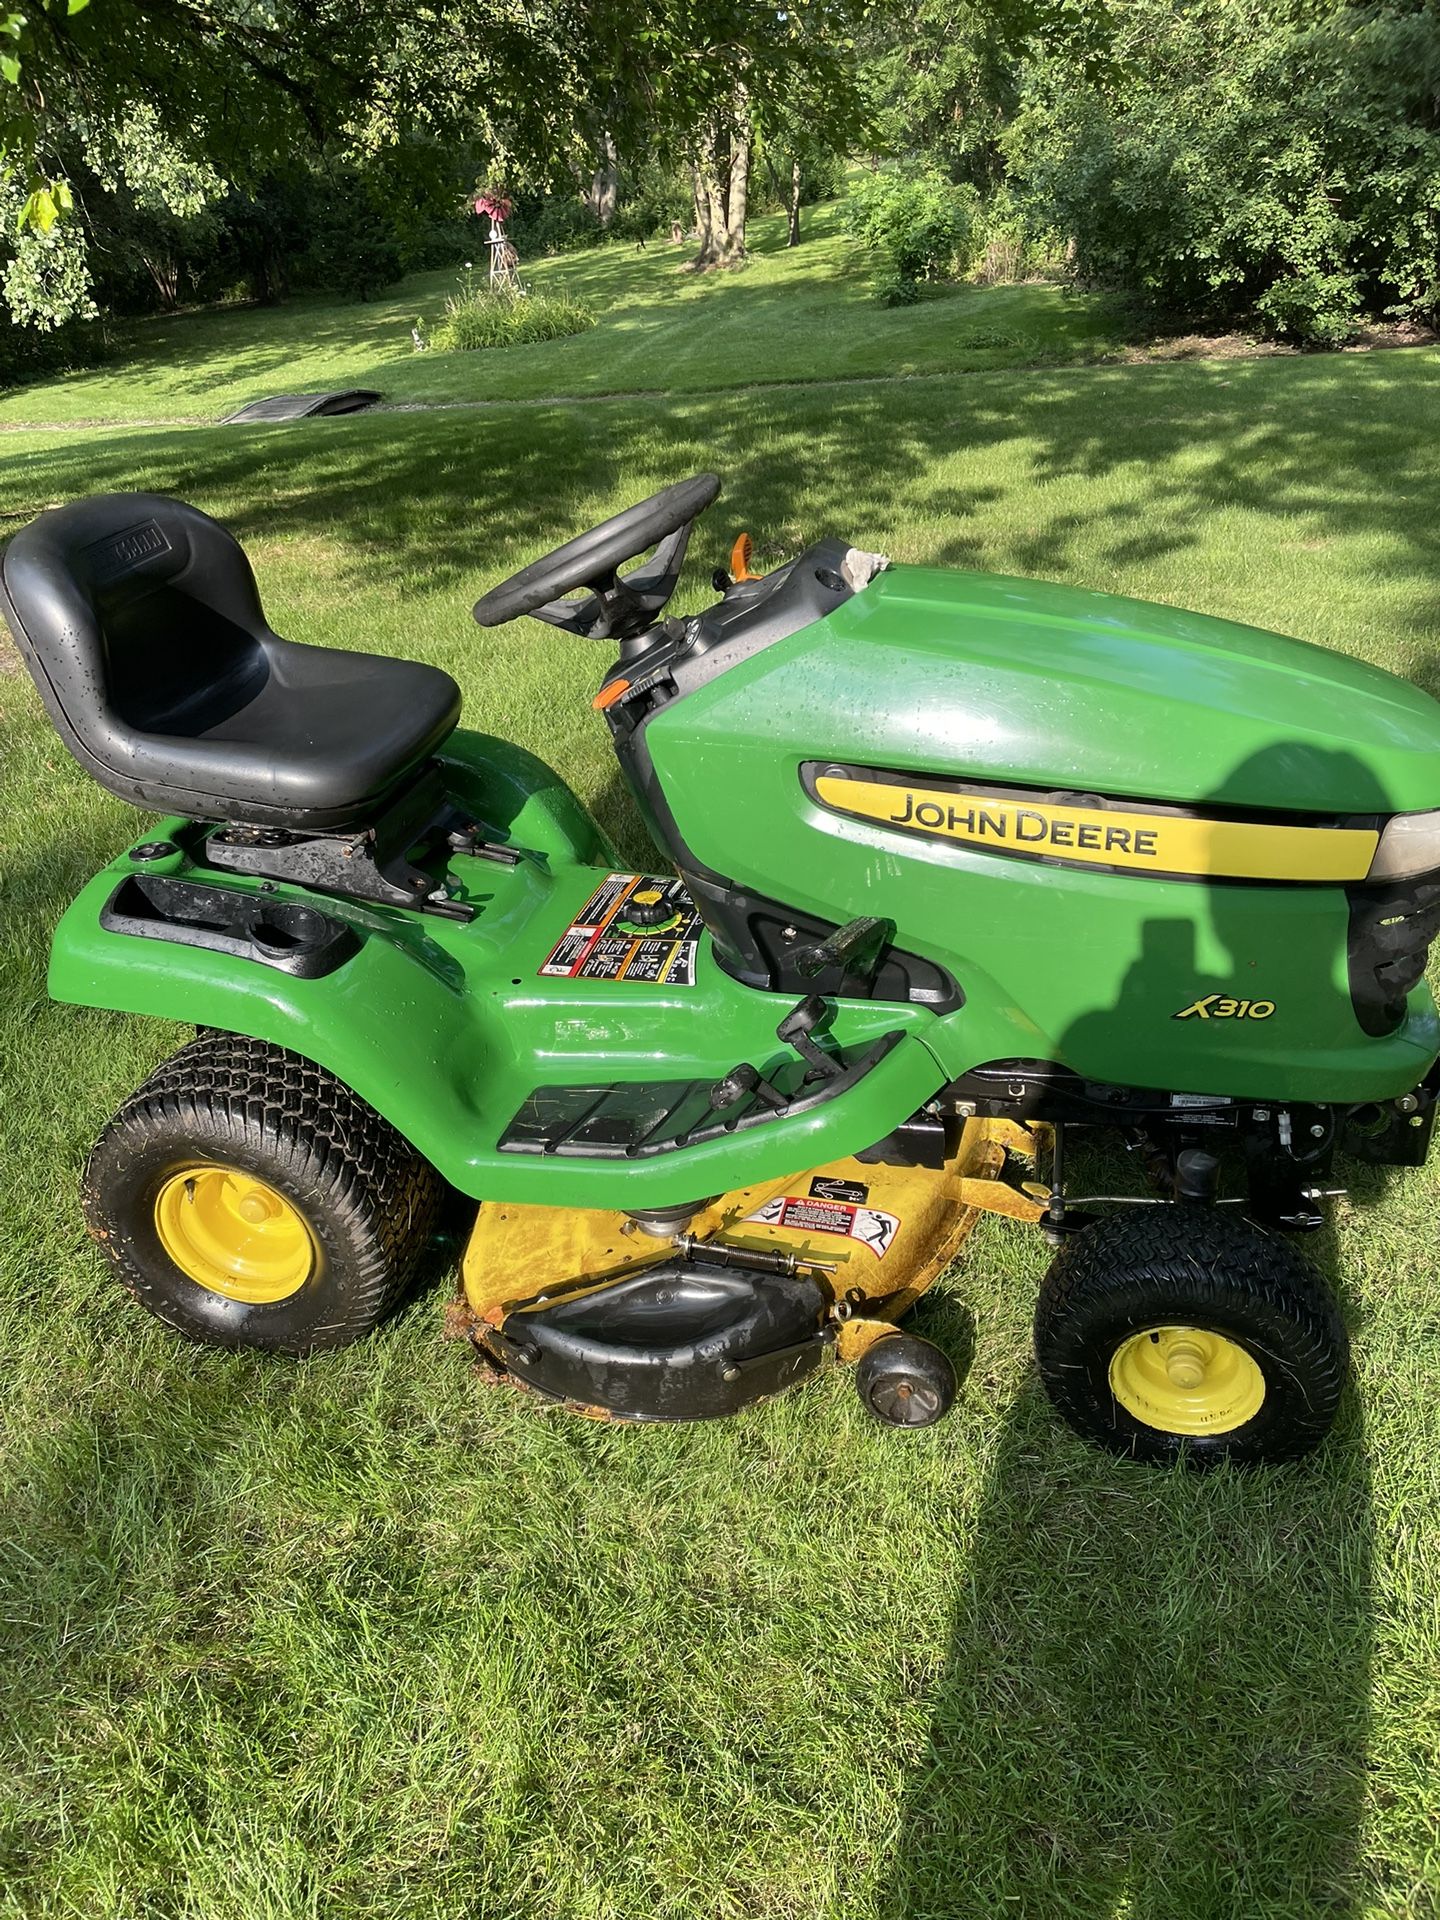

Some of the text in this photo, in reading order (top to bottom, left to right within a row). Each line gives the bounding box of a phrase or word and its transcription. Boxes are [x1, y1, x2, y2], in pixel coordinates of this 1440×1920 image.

[890, 793, 1158, 856] JOHN DEERE
[1173, 994, 1276, 1019] X310
[806, 1200, 847, 1211] DANGER
